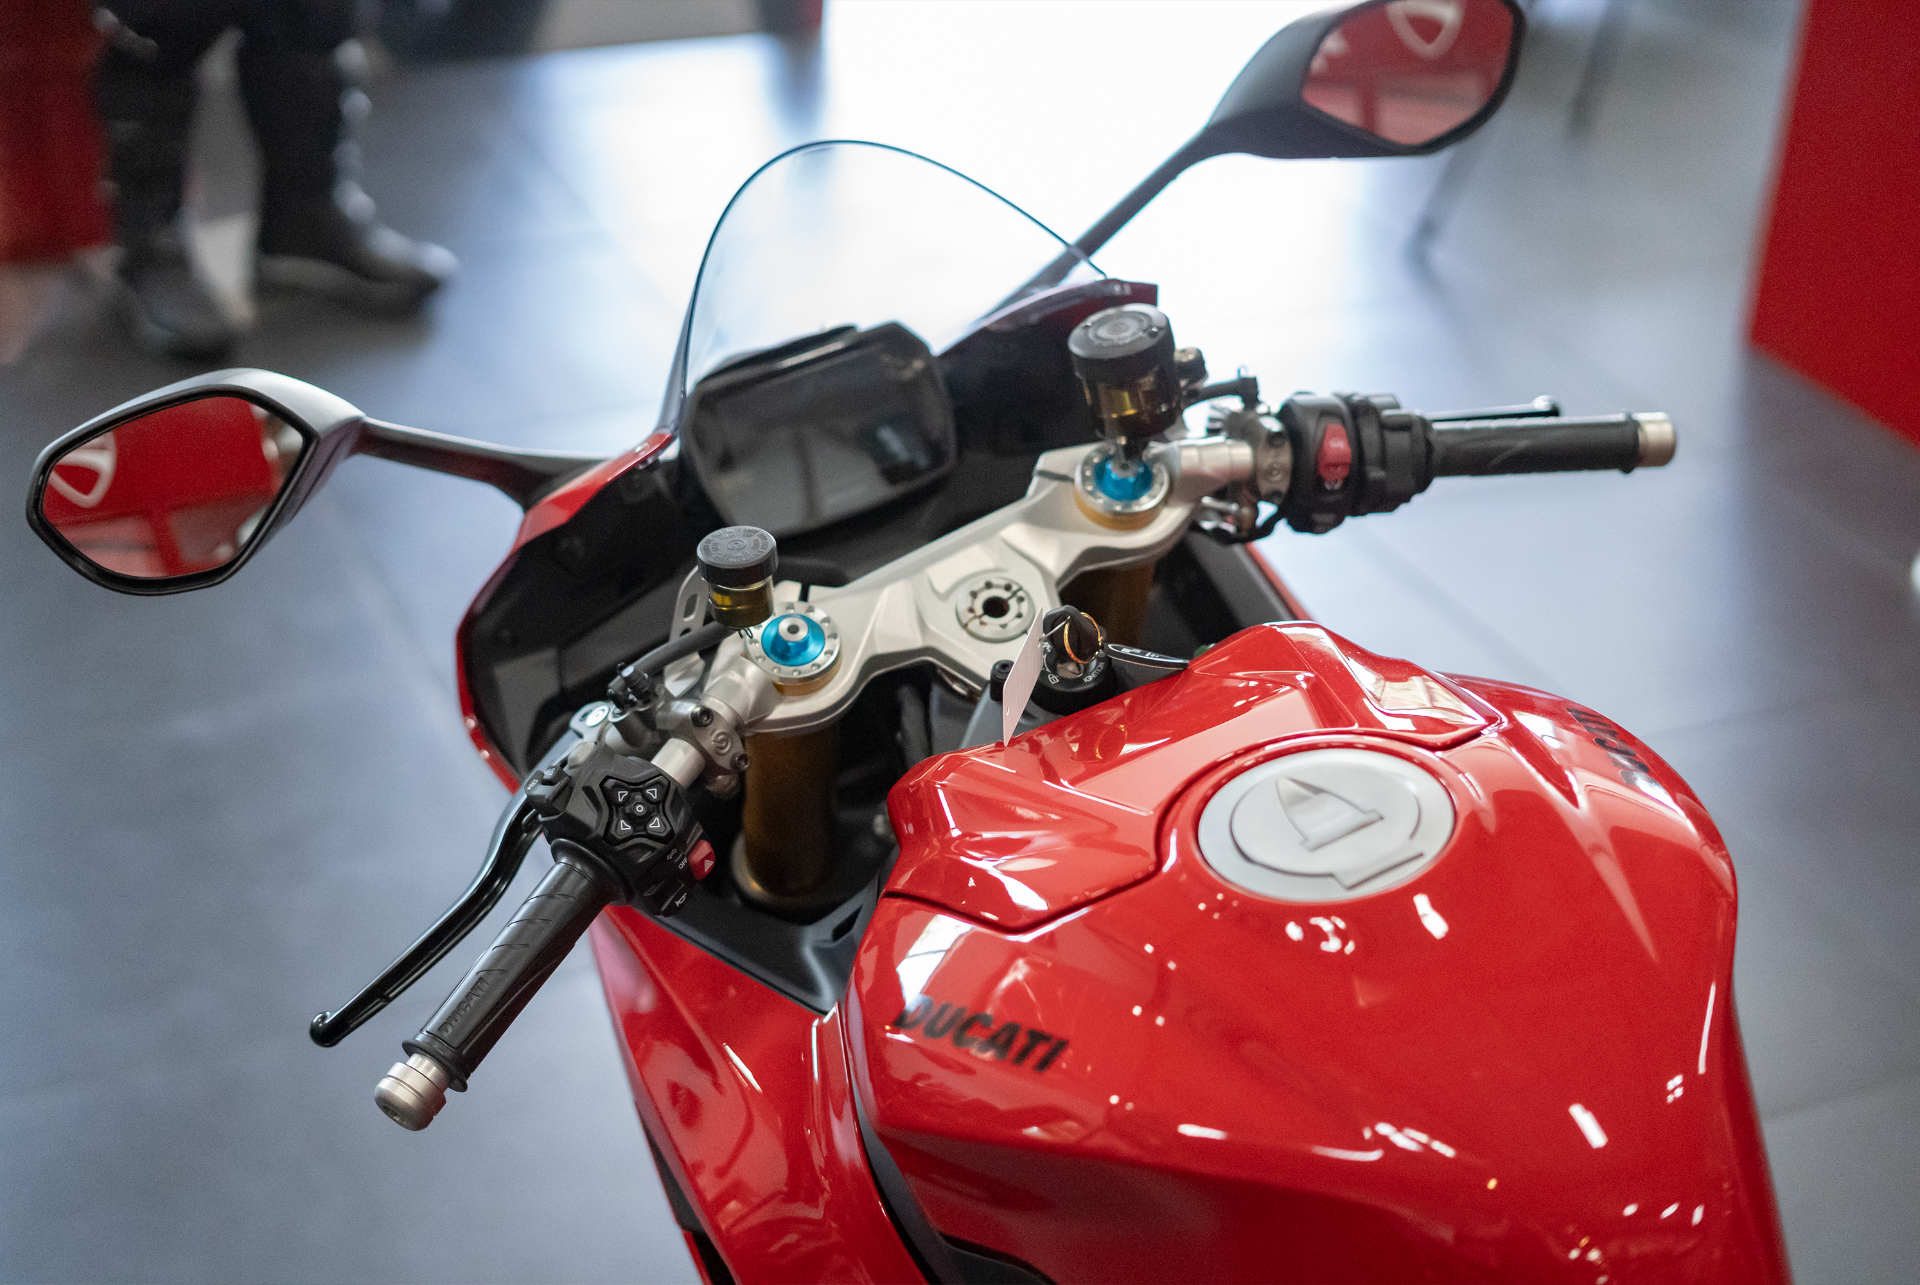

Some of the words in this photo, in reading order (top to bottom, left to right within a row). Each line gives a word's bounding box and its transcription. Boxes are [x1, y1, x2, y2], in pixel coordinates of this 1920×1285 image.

[1083, 662, 1105, 682] IGNITION
[678, 856, 688, 870] OFF
[437, 976, 490, 1038] DUCATI
[892, 993, 1069, 1073] DUCATI
